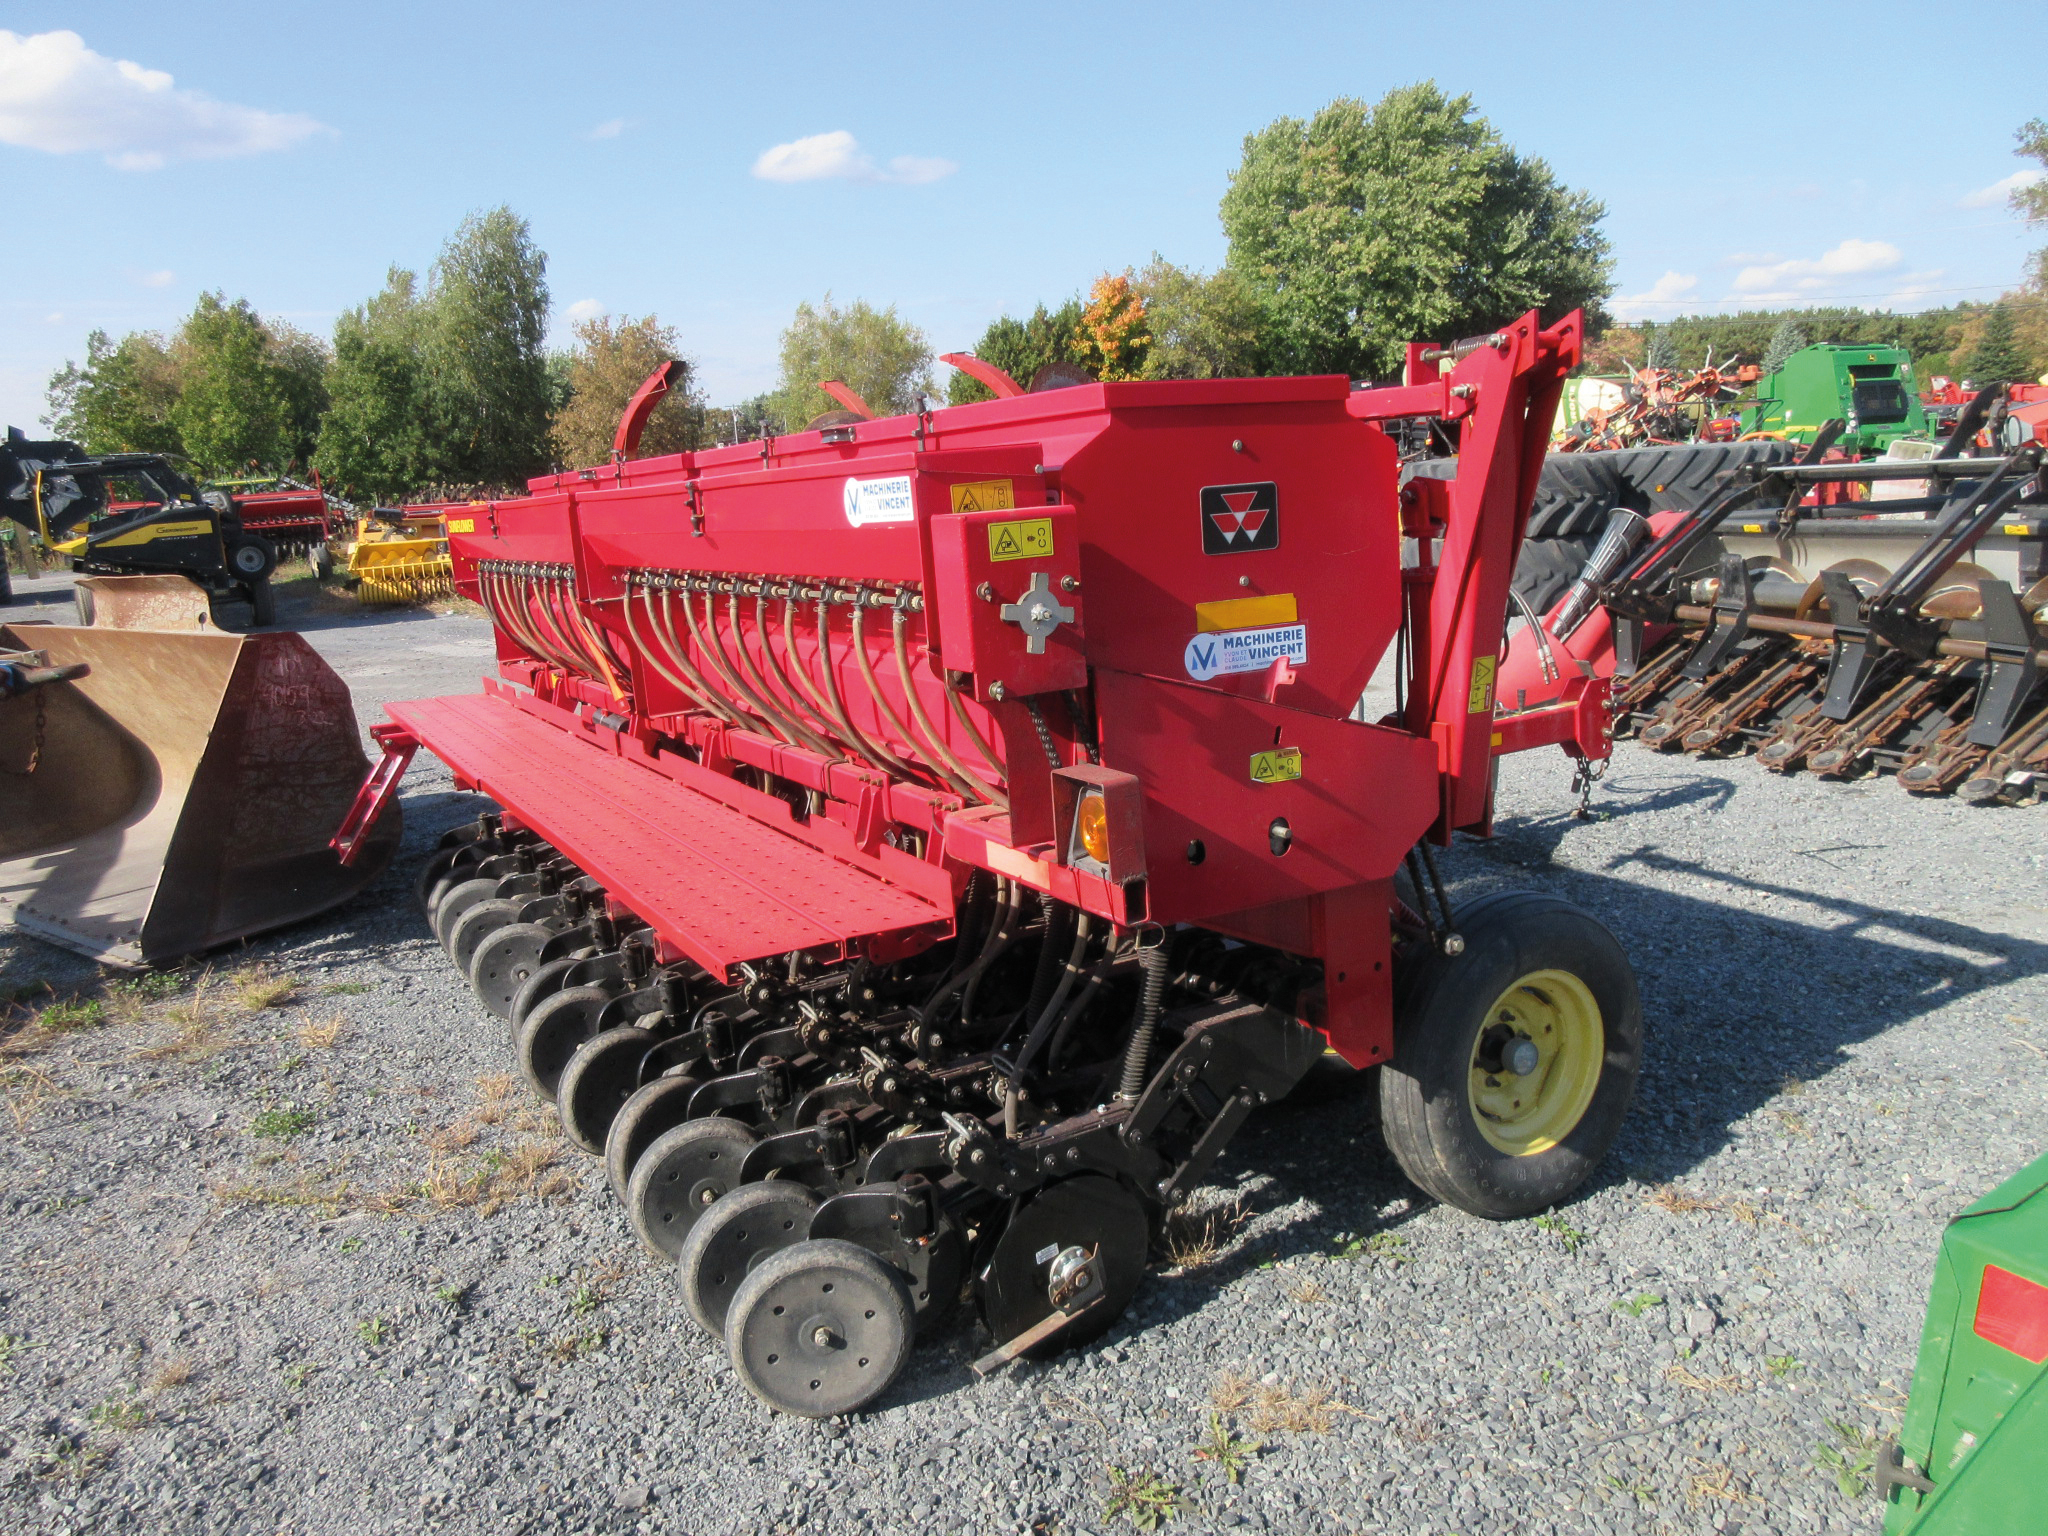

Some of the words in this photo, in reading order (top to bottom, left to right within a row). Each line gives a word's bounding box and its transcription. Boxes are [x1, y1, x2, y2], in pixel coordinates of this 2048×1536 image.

[863, 481, 909, 496] MACHINERIE
[877, 497, 910, 510] VINCENT
[1223, 629, 1303, 649] MACHINERIE
[1248, 642, 1303, 660] VINCENT
[1224, 655, 1247, 664] CLAUDE
